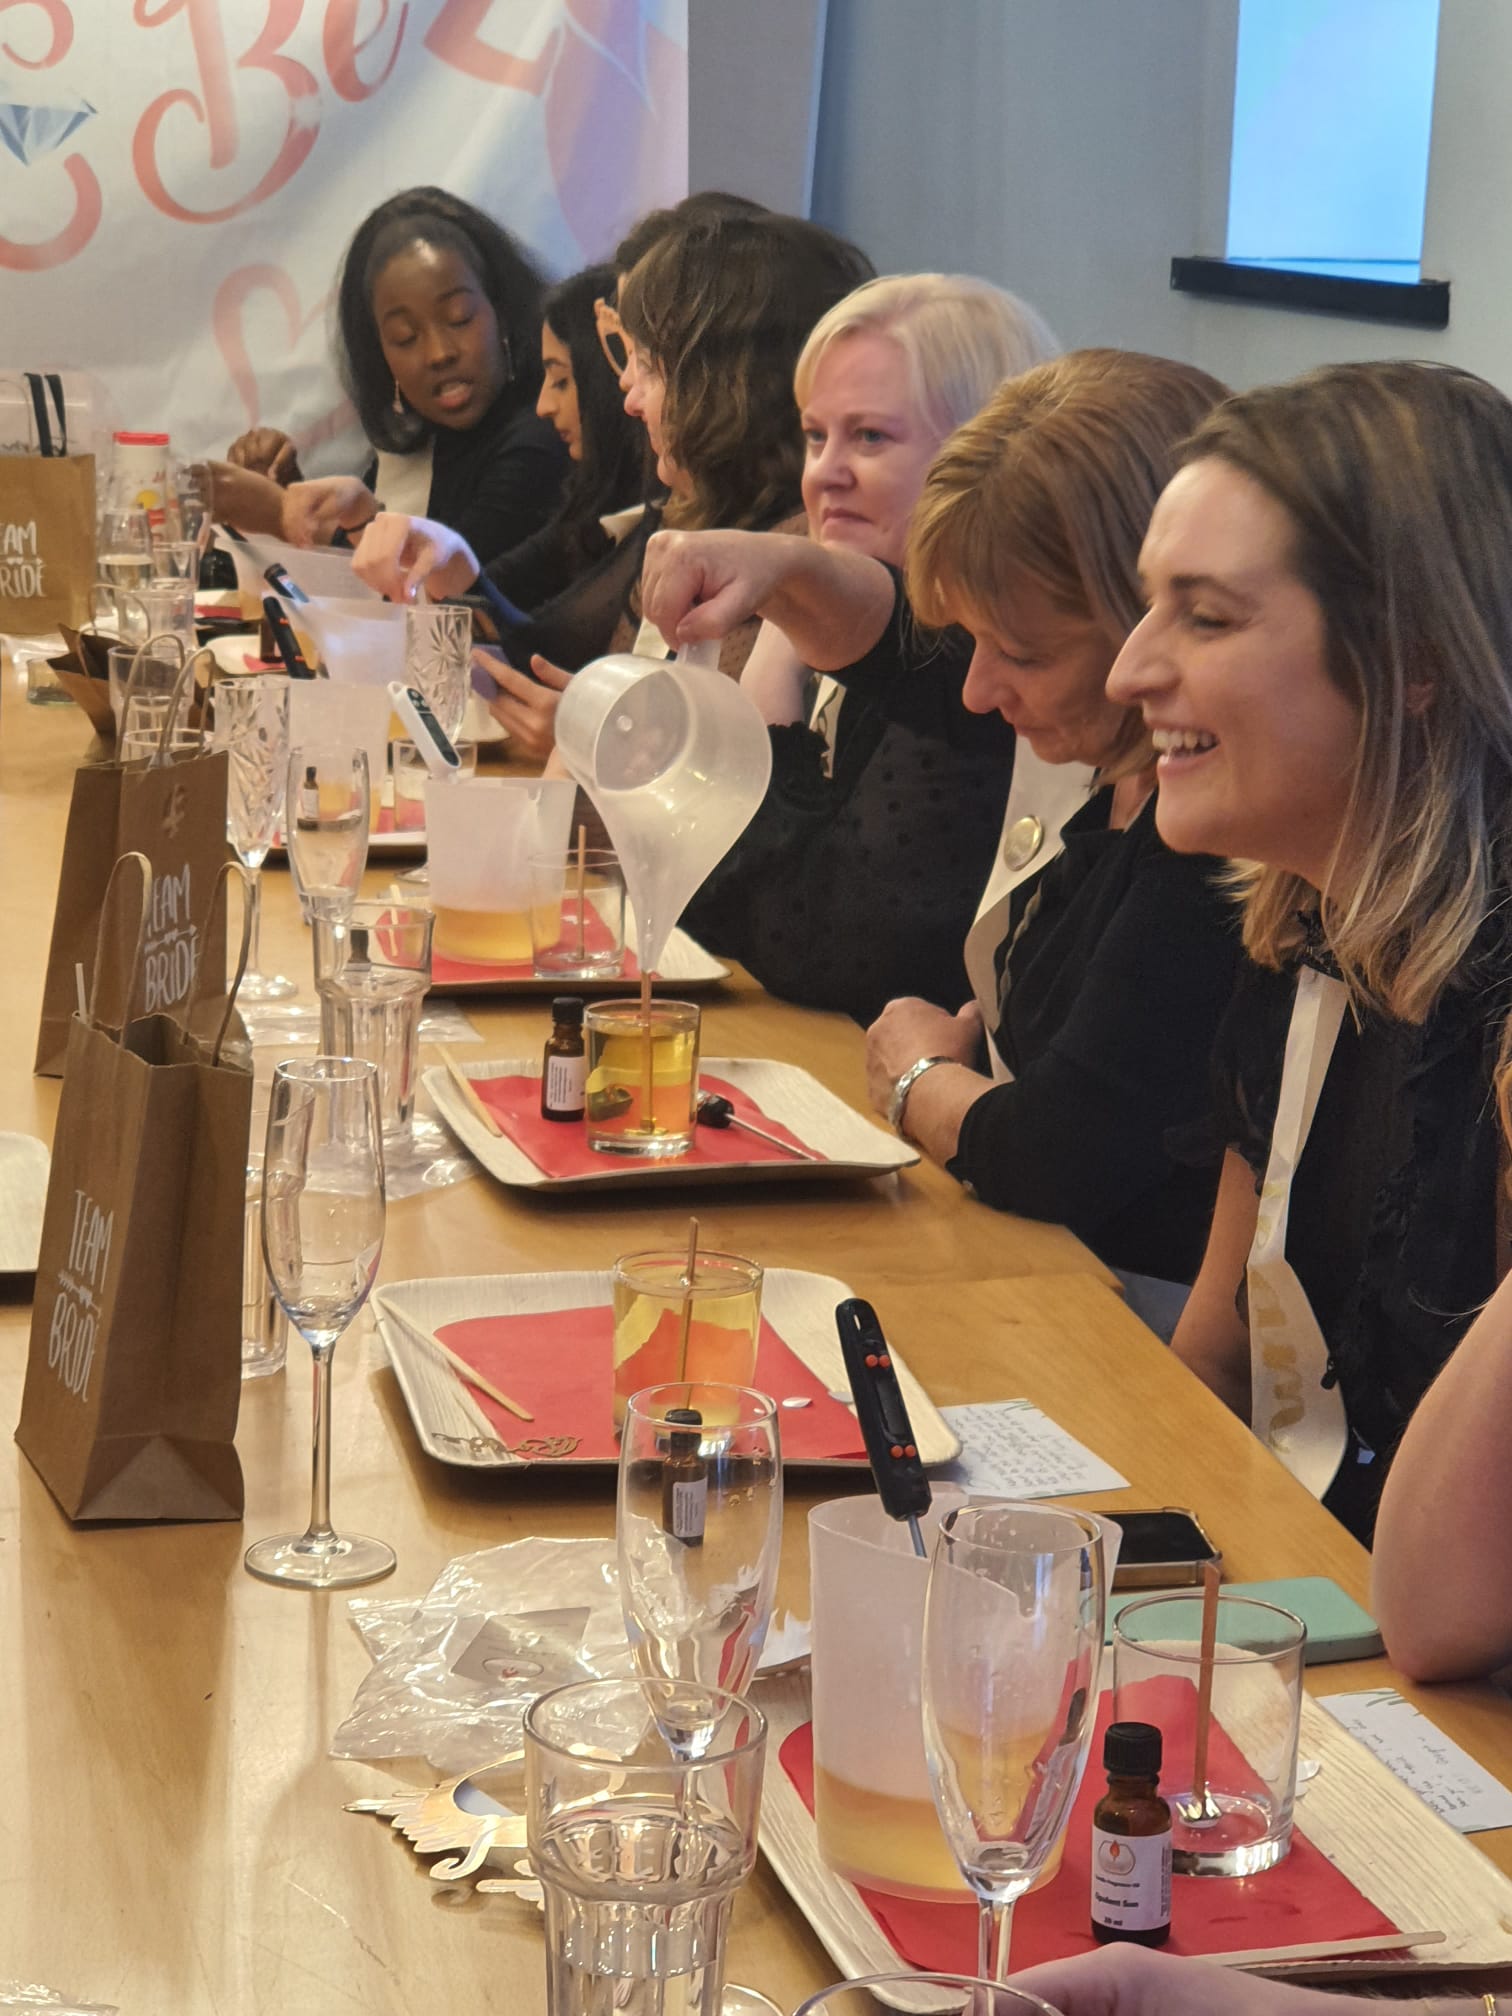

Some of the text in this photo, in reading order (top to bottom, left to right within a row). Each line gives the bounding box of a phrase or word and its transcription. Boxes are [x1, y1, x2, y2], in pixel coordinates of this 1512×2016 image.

[0, 520, 37, 555] AM
[148, 863, 192, 936] EAM
[144, 934, 201, 1013] BRIDE
[68, 1189, 114, 1294] TEAM
[48, 1291, 100, 1403] BRIDE
